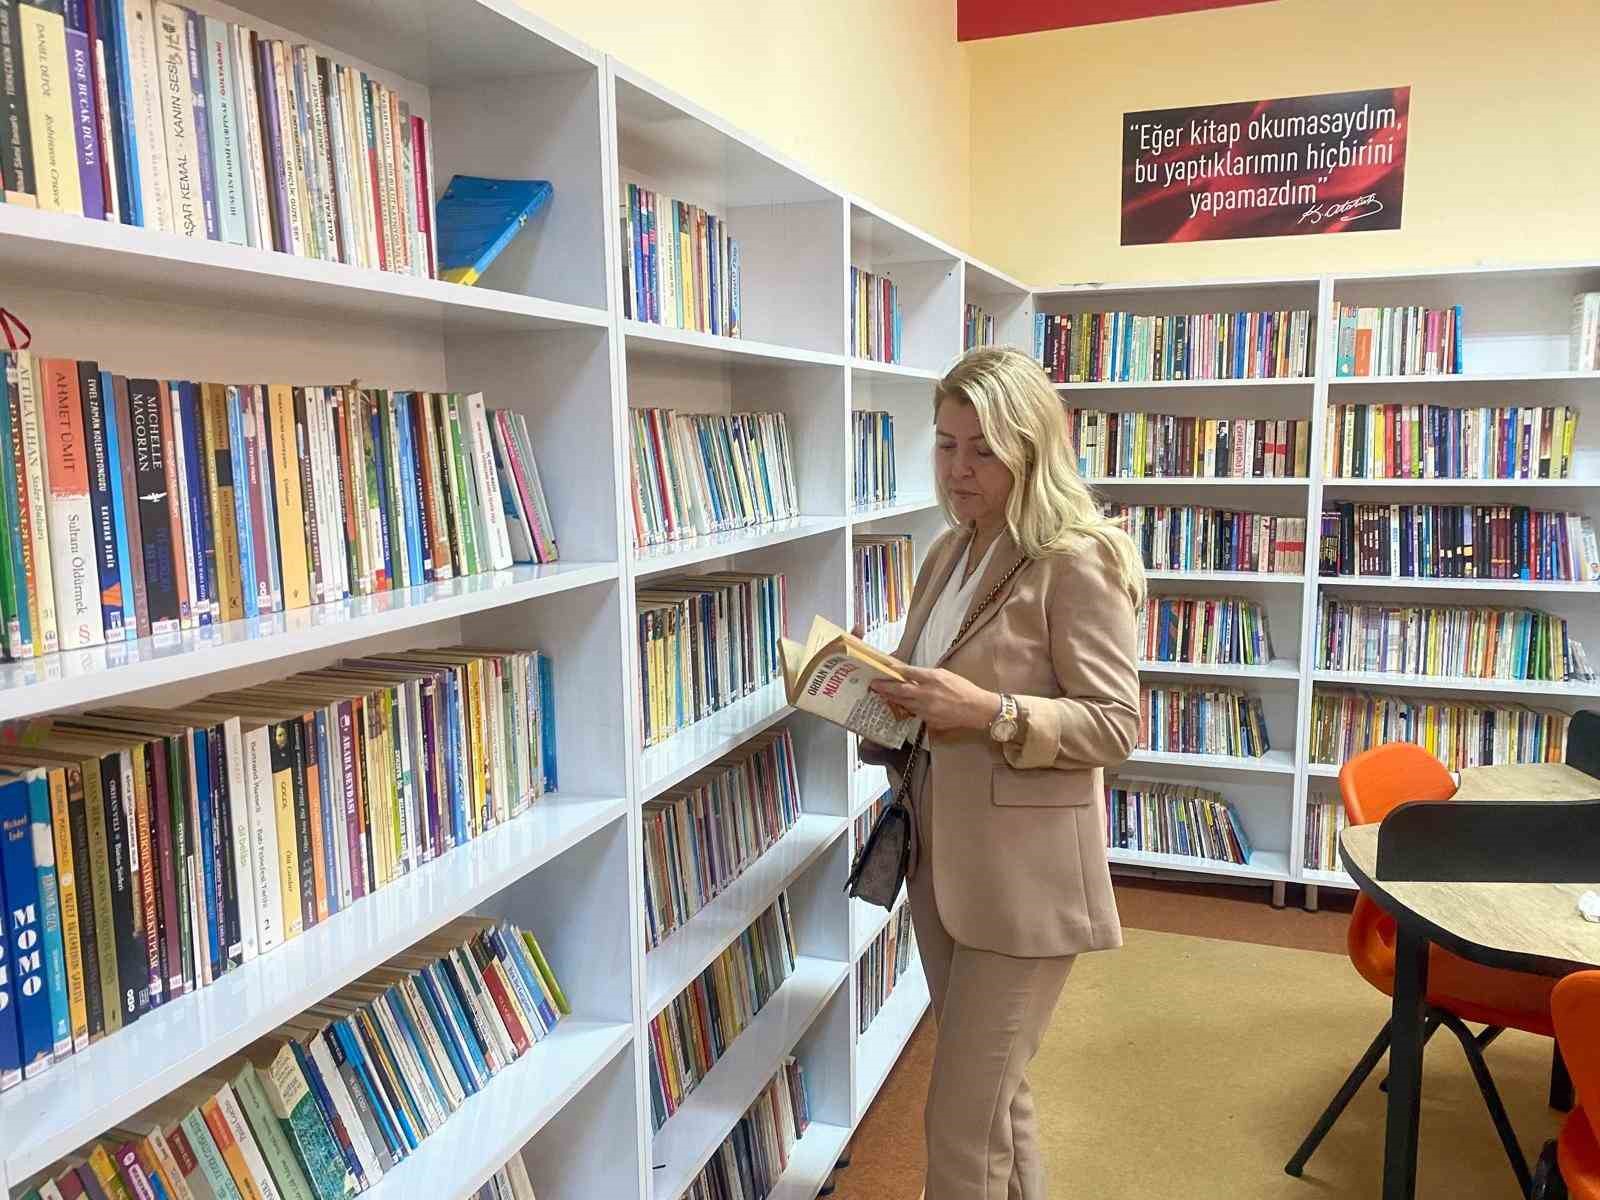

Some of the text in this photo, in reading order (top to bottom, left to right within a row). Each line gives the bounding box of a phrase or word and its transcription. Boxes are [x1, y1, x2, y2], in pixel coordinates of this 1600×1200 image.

[36, 24, 47, 62] DANIEL
[167, 61, 181, 93] SESİ
[77, 83, 91, 124] BUCAK
[170, 96, 184, 138] KANIN
[81, 126, 95, 166] DÜNYA
[1191, 119, 1241, 147] kitap
[1248, 104, 1402, 141] okumasaydım,
[1135, 138, 1394, 187] bu yaptıklarımın hiçbirini
[178, 154, 197, 239] AŞAR KEMAL
[324, 193, 335, 242] KALEKALE
[1189, 177, 1328, 217] yapamazdım”
[87, 379, 98, 400] EVVEL
[55, 372, 76, 472] AHMET ÜMİT
[88, 401, 101, 429] ZAMAN
[133, 393, 149, 472] MAGORIAN
[147, 396, 162, 470] MICHELLE
[66, 514, 87, 616] Sultanı Öldürmek
[808, 669, 828, 697] ORHAN
[342, 735, 352, 773] ARABA
[108, 780, 119, 808] ORHAN
[250, 741, 262, 813] Bertrand Russell
[345, 773, 355, 814] SEVDASI
[138, 814, 160, 969] DEĞİRMENİMDEN MEKTUPLAR
[13, 905, 42, 997] MOMO
